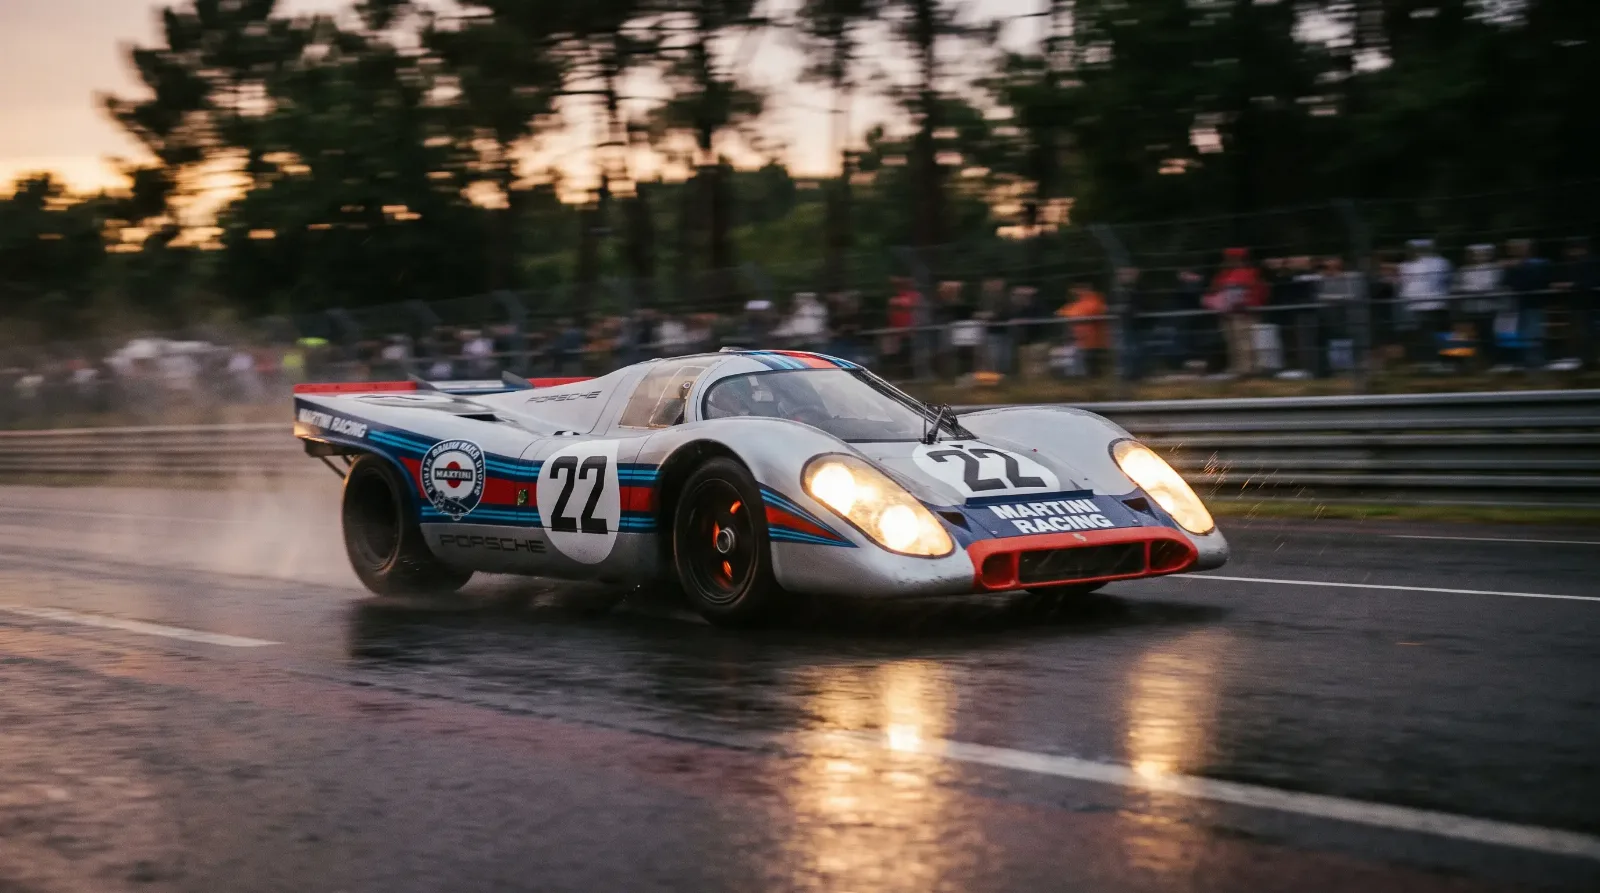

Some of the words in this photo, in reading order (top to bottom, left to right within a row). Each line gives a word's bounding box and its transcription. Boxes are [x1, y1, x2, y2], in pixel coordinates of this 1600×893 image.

[525, 390, 602, 404] PORSCHE
[927, 448, 1048, 492] 22
[550, 456, 608, 534] 22
[988, 499, 1101, 519] MARTINI
[1012, 514, 1115, 534] RACING
